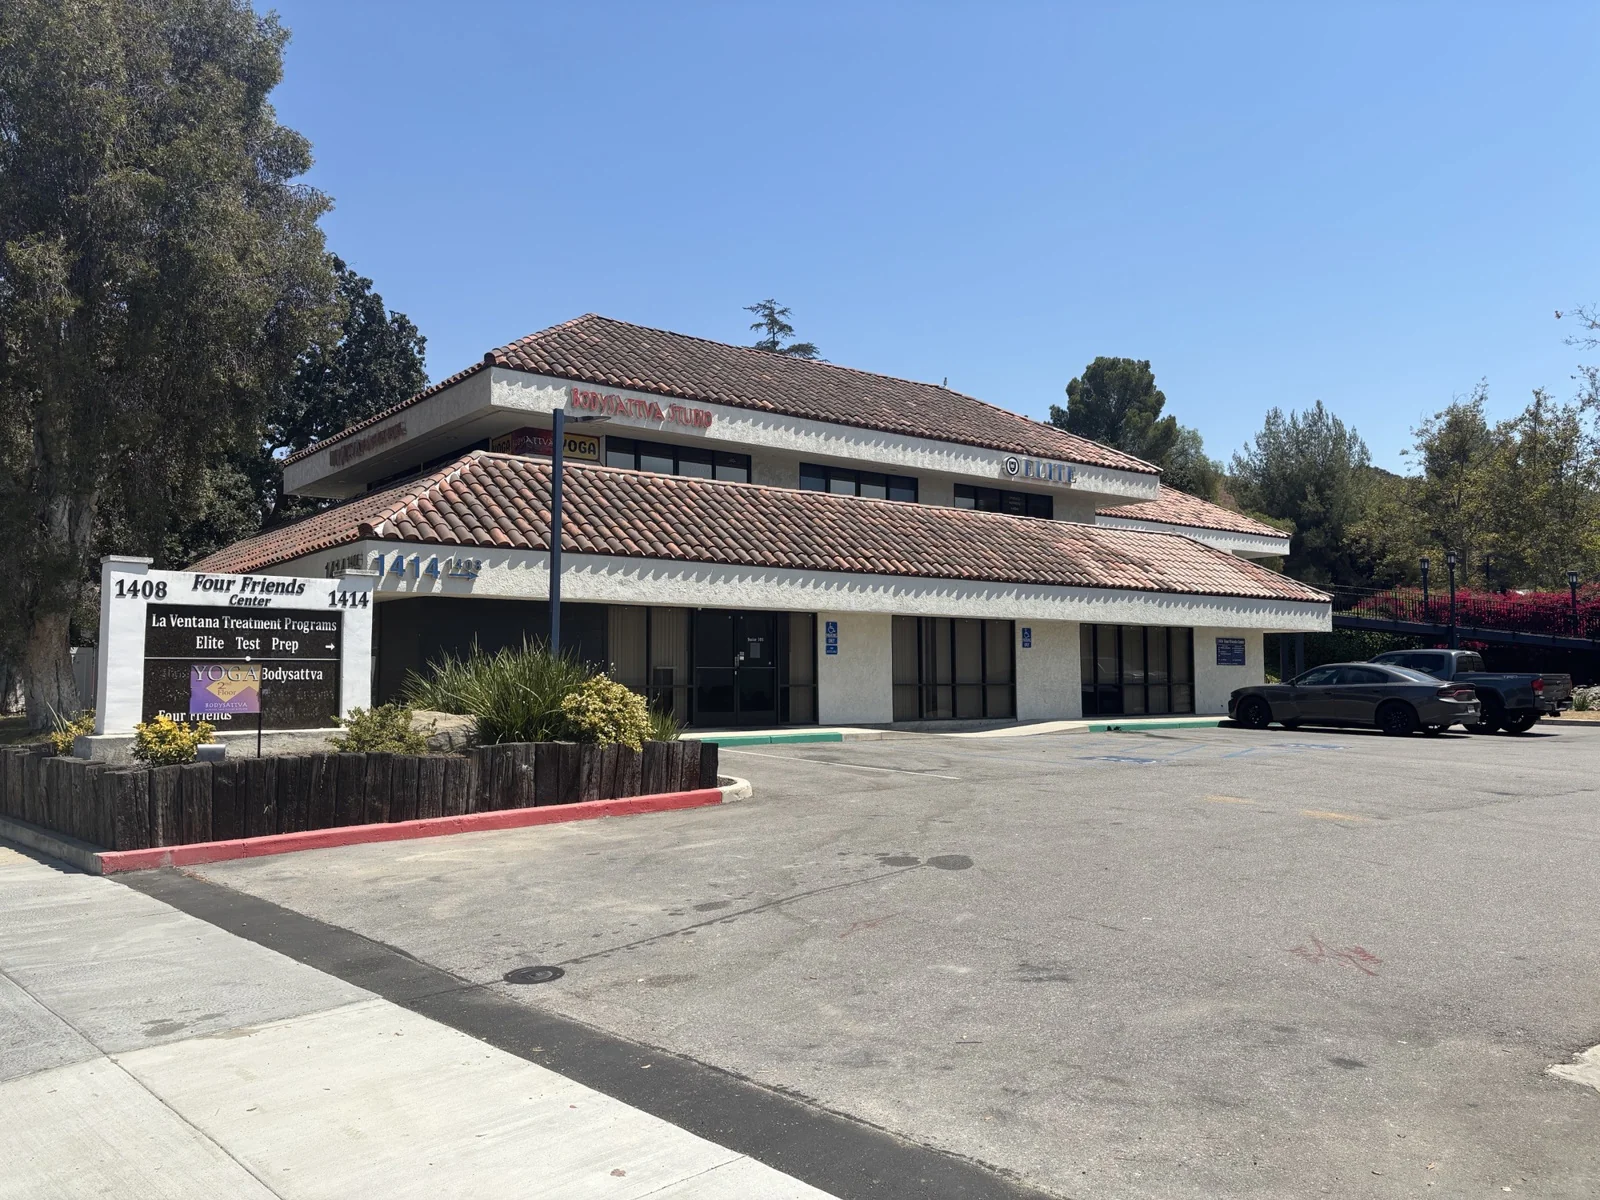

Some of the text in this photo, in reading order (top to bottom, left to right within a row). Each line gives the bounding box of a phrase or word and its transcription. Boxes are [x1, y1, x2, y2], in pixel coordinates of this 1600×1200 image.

[571, 388, 713, 428] BODYSATTVA STUDIO
[562, 438, 597, 456] OGA
[1021, 459, 1077, 483] ELITE
[375, 554, 440, 579] 1414
[115, 578, 167, 600] 1408
[191, 574, 306, 595] Four Friends
[229, 594, 271, 607] Center
[327, 589, 370, 608] 1414
[152, 613, 337, 633] La Ventana Treatment Programs
[195, 635, 299, 653] Elite Test Prep
[192, 664, 259, 682] YOGA
[262, 667, 323, 683] Bodysattva
[158, 709, 186, 721] Four
